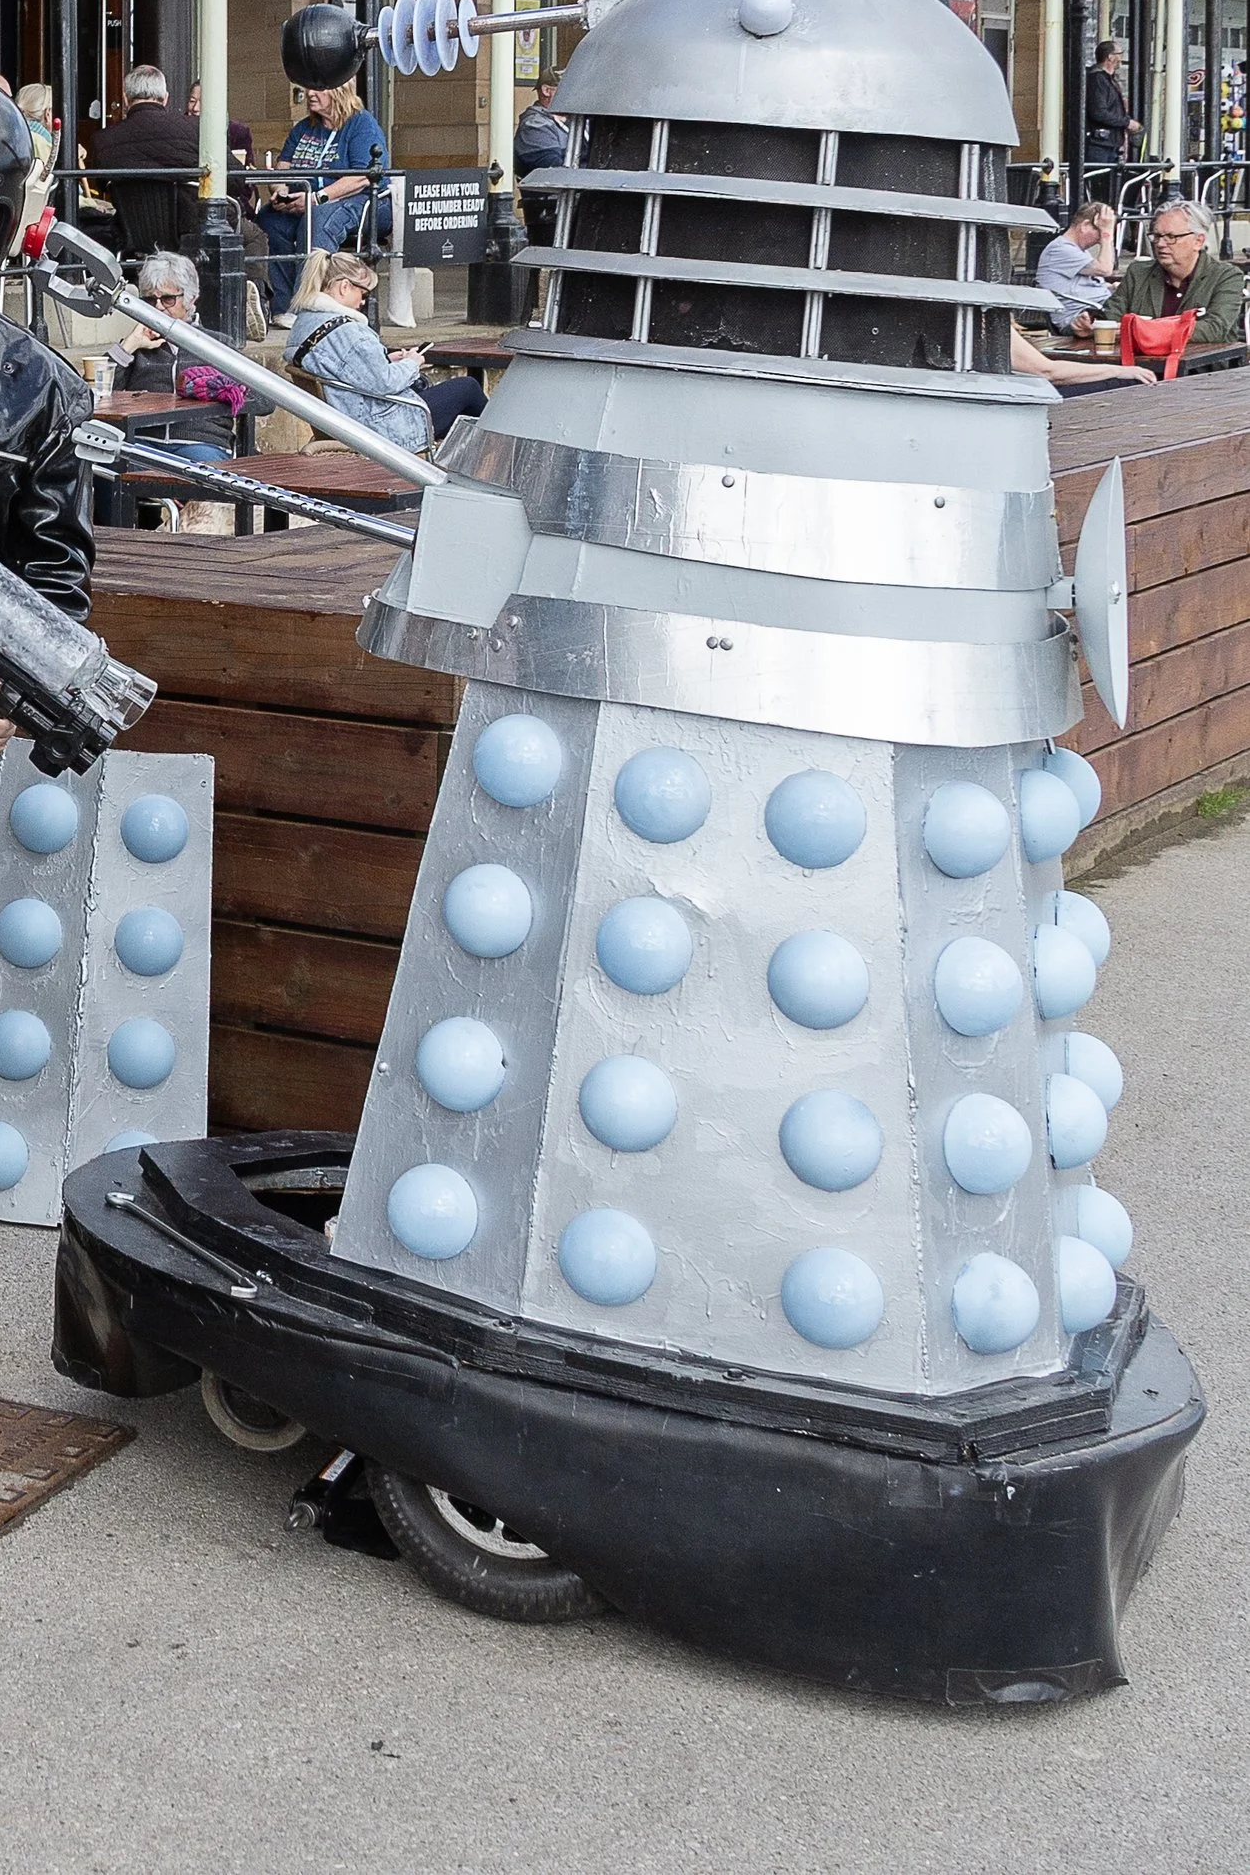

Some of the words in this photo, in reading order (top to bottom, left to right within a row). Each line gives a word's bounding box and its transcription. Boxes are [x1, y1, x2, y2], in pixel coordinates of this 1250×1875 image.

[107, 19, 122, 27] PUSH
[414, 184, 440, 198] PLEASE
[441, 183, 459, 197] HAVE
[460, 182, 480, 196] YOUR
[408, 201, 431, 216] TABLE
[432, 199, 462, 214] NUMBER
[463, 198, 486, 213] READY
[415, 217, 442, 231] BEFORE
[443, 215, 478, 230] ORDERING
